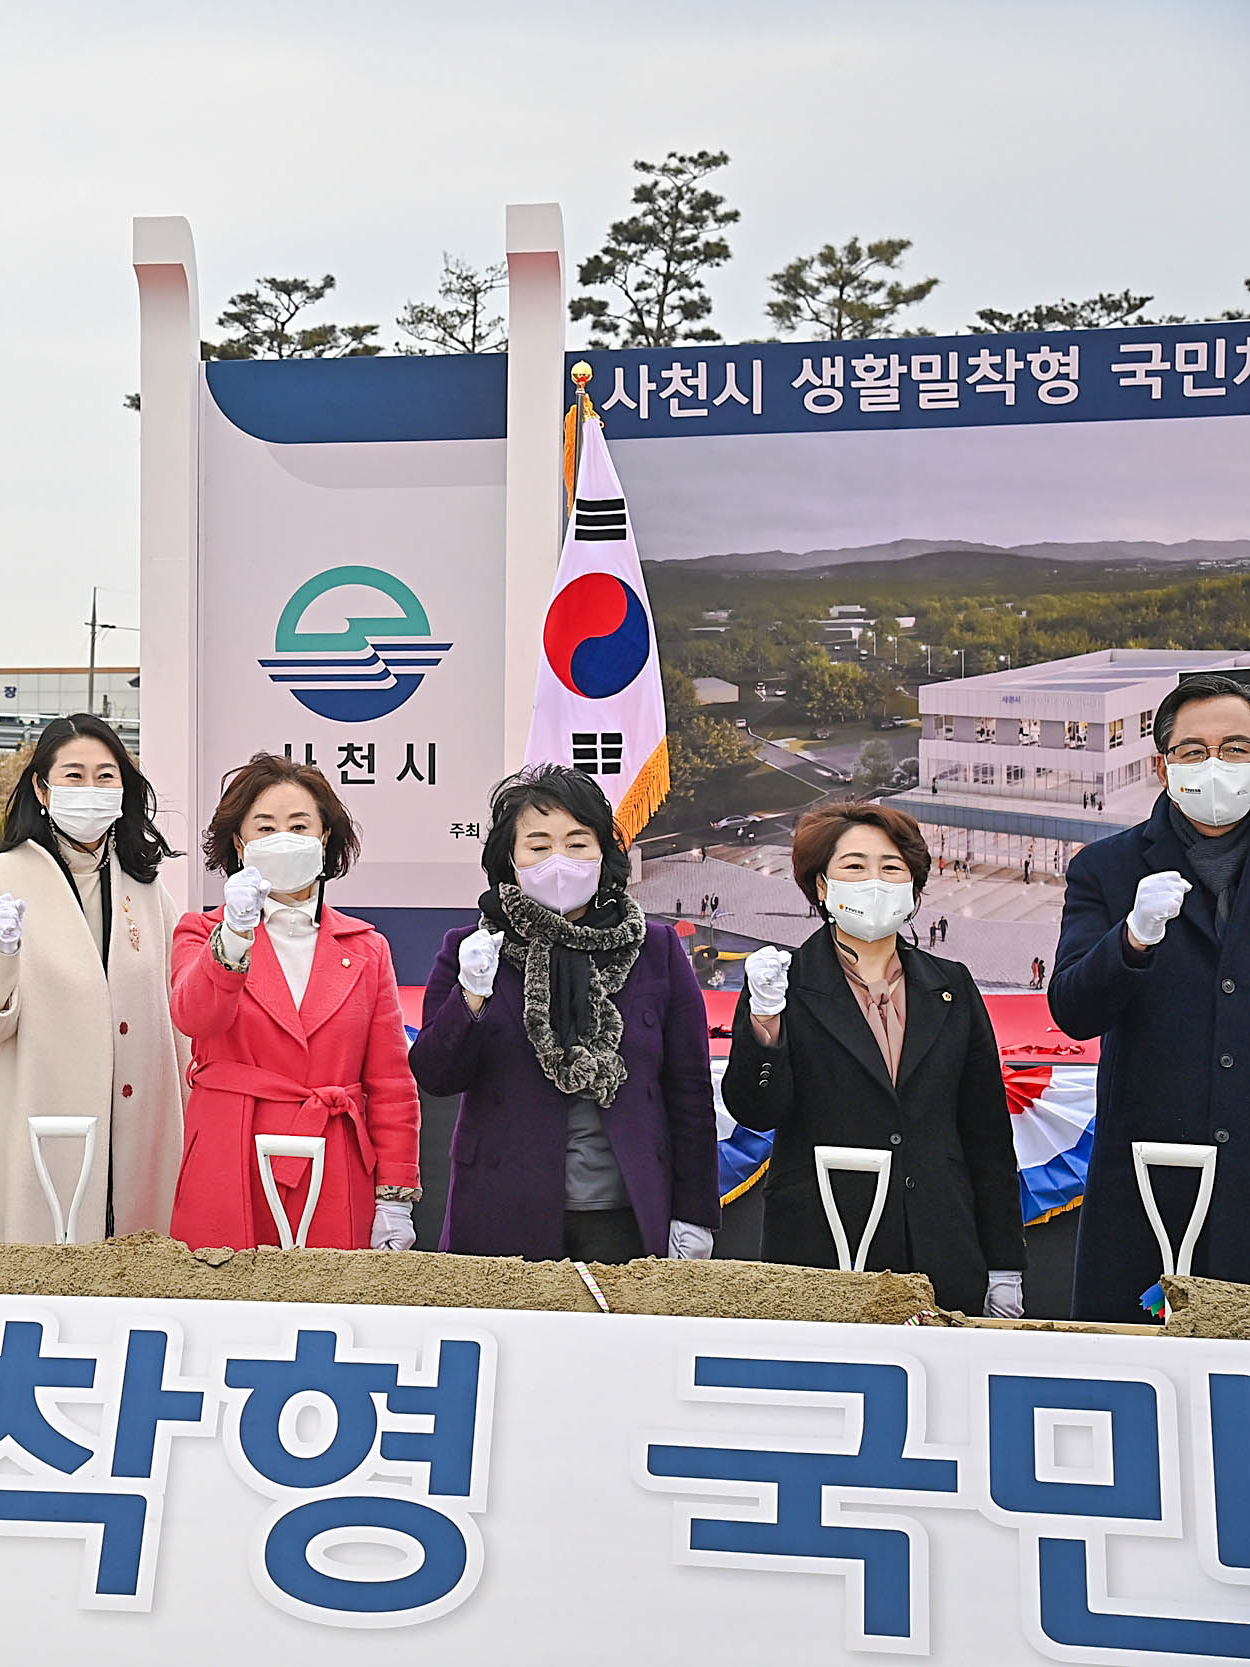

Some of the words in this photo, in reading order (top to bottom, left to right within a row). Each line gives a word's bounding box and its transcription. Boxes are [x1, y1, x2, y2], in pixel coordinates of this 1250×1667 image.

[601, 358, 762, 419] 사천시
[791, 345, 1079, 414] 생활밀착형
[449, 822, 480, 839] 주최
[646, 1355, 1250, 1659] 국민
